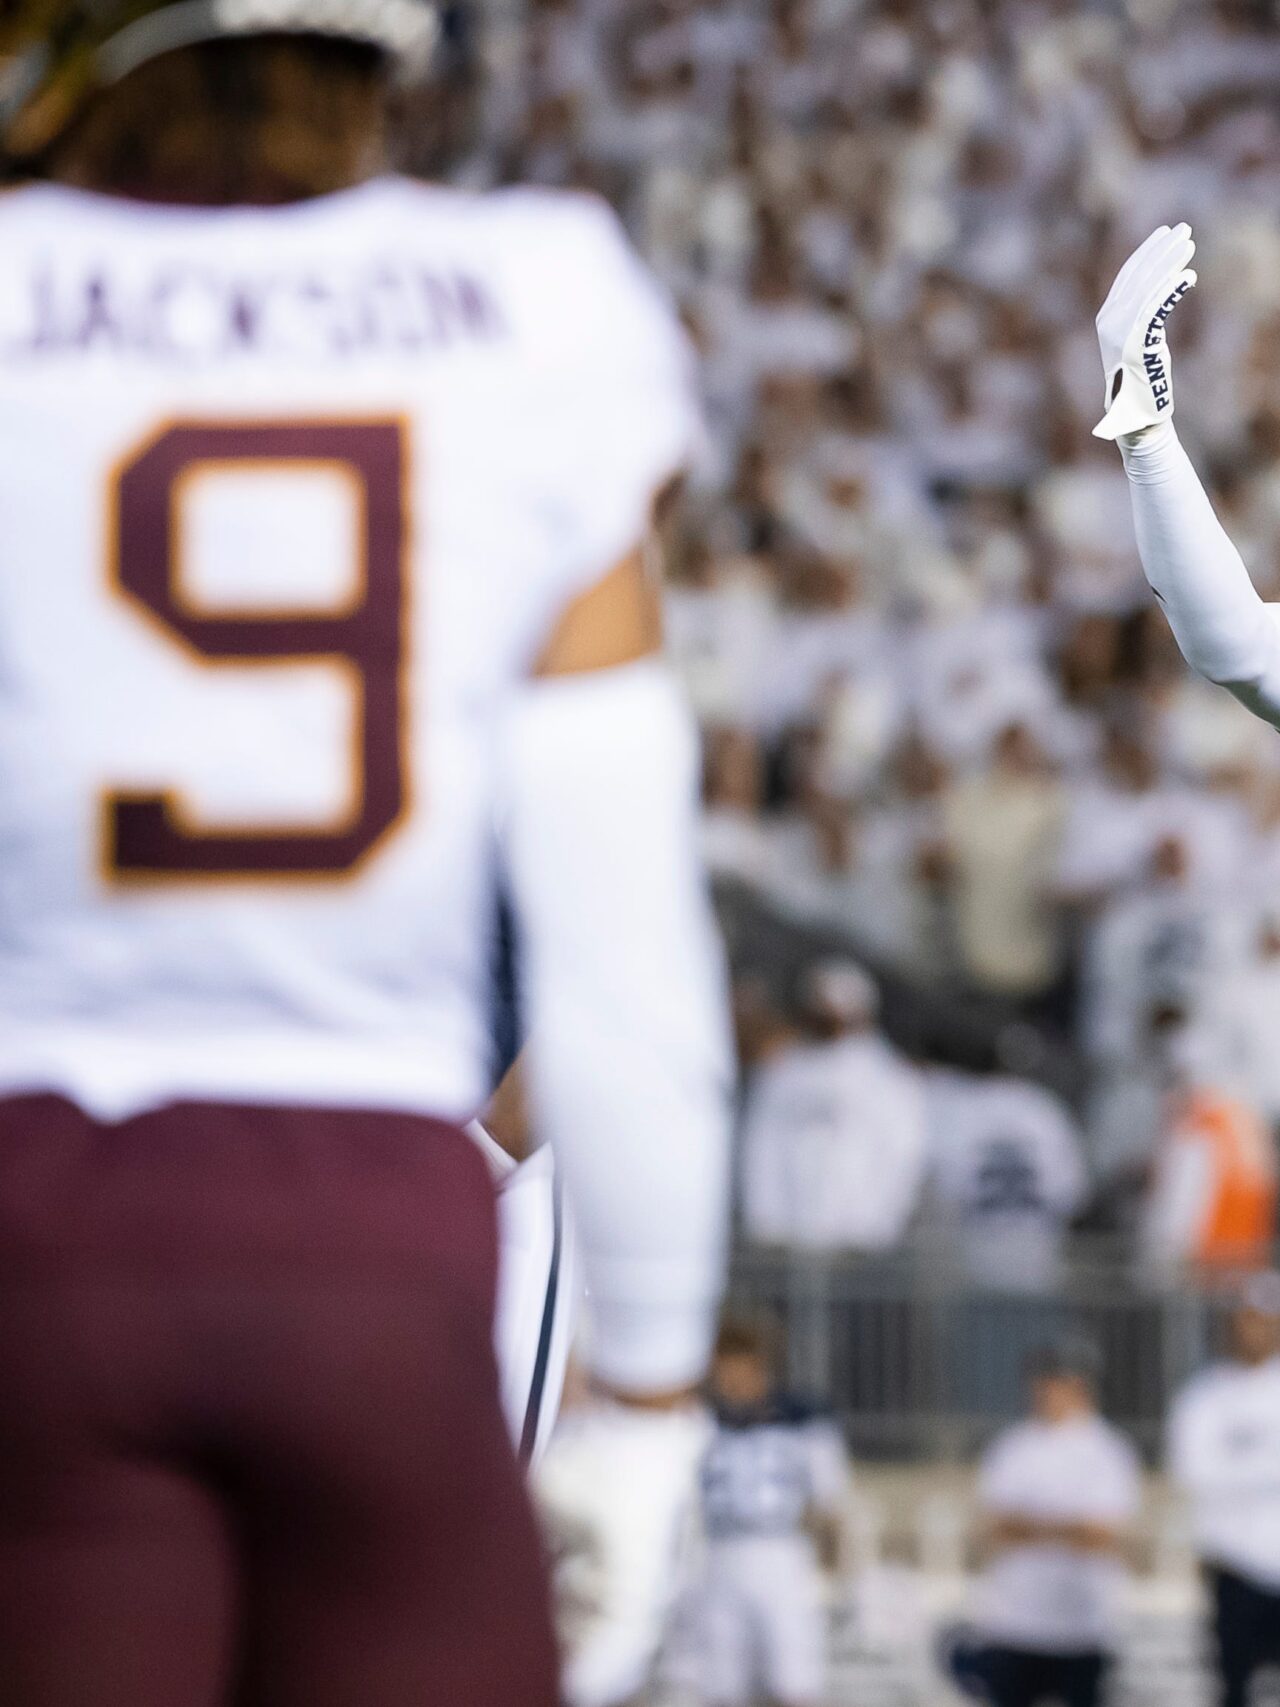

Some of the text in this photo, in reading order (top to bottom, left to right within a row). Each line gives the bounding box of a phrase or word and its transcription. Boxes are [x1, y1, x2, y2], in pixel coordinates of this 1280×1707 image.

[8, 264, 506, 360] JACKSON
[1143, 281, 1189, 412] PENN STATE
[104, 411, 414, 886] 9
